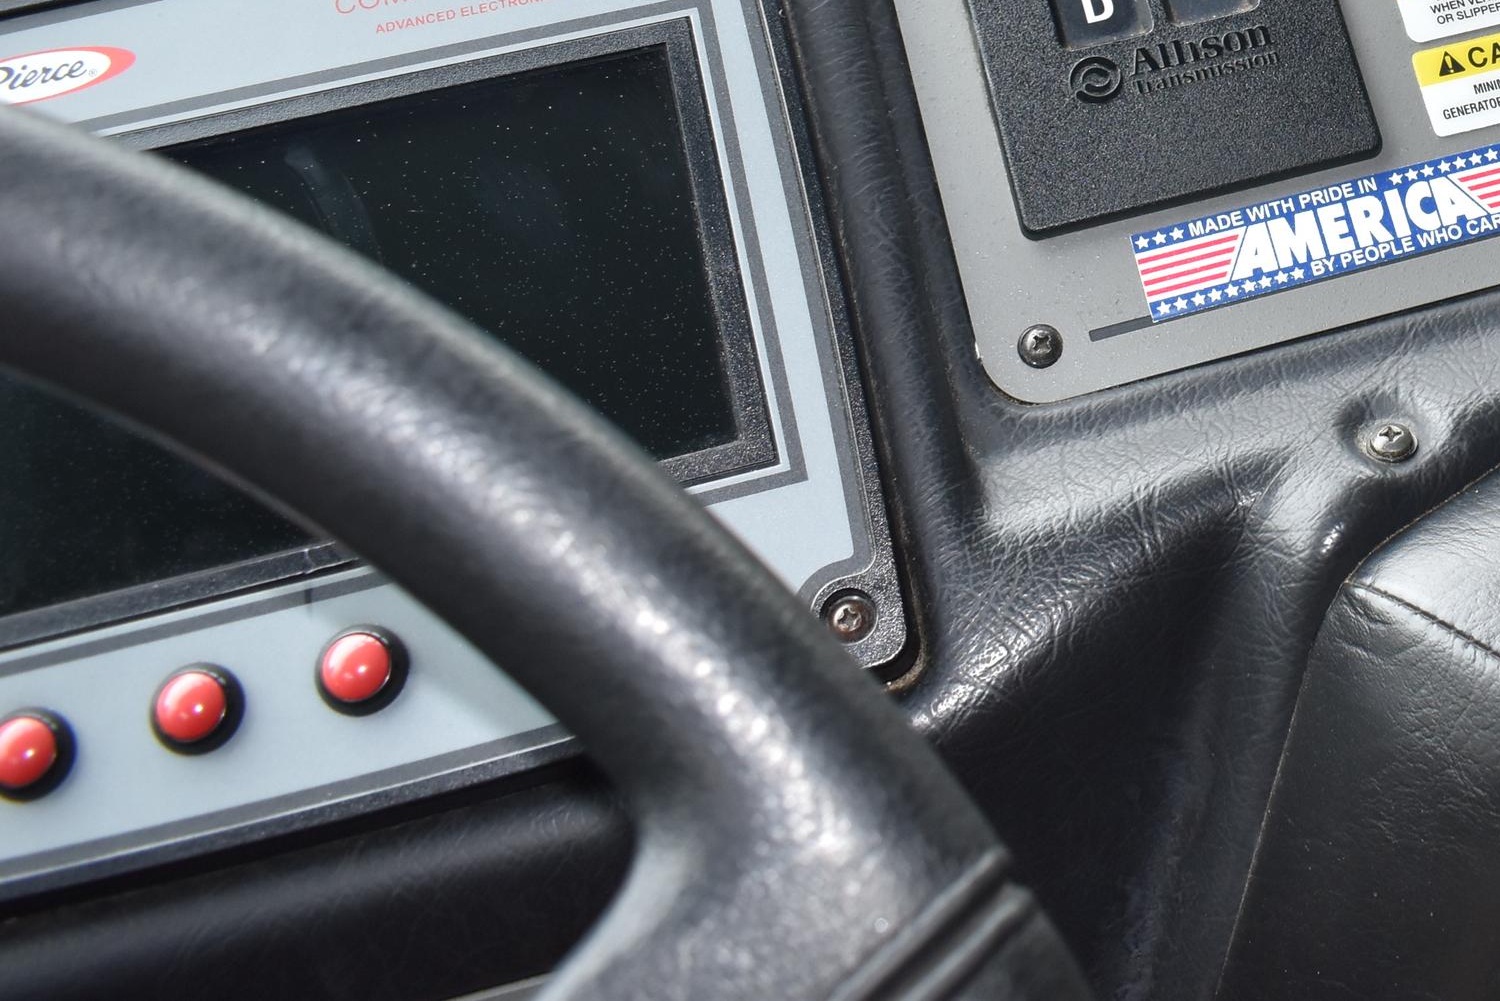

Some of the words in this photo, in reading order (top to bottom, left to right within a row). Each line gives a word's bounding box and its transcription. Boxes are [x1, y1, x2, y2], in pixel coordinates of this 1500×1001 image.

[375, 9, 456, 34] ADVANCED
[1437, 12, 1454, 25] OR
[1131, 24, 1272, 77] Allison
[1132, 51, 1279, 95] Transmission
[1188, 211, 1245, 237] MADE
[1247, 199, 1296, 224] WITH
[1299, 185, 1354, 211] PRIDE
[1357, 177, 1378, 194] IN
[1231, 175, 1489, 281] AMERICA
[1312, 258, 1336, 277] BY
[1340, 240, 1413, 270] PEOPLE
[1417, 225, 1462, 247] WHO
